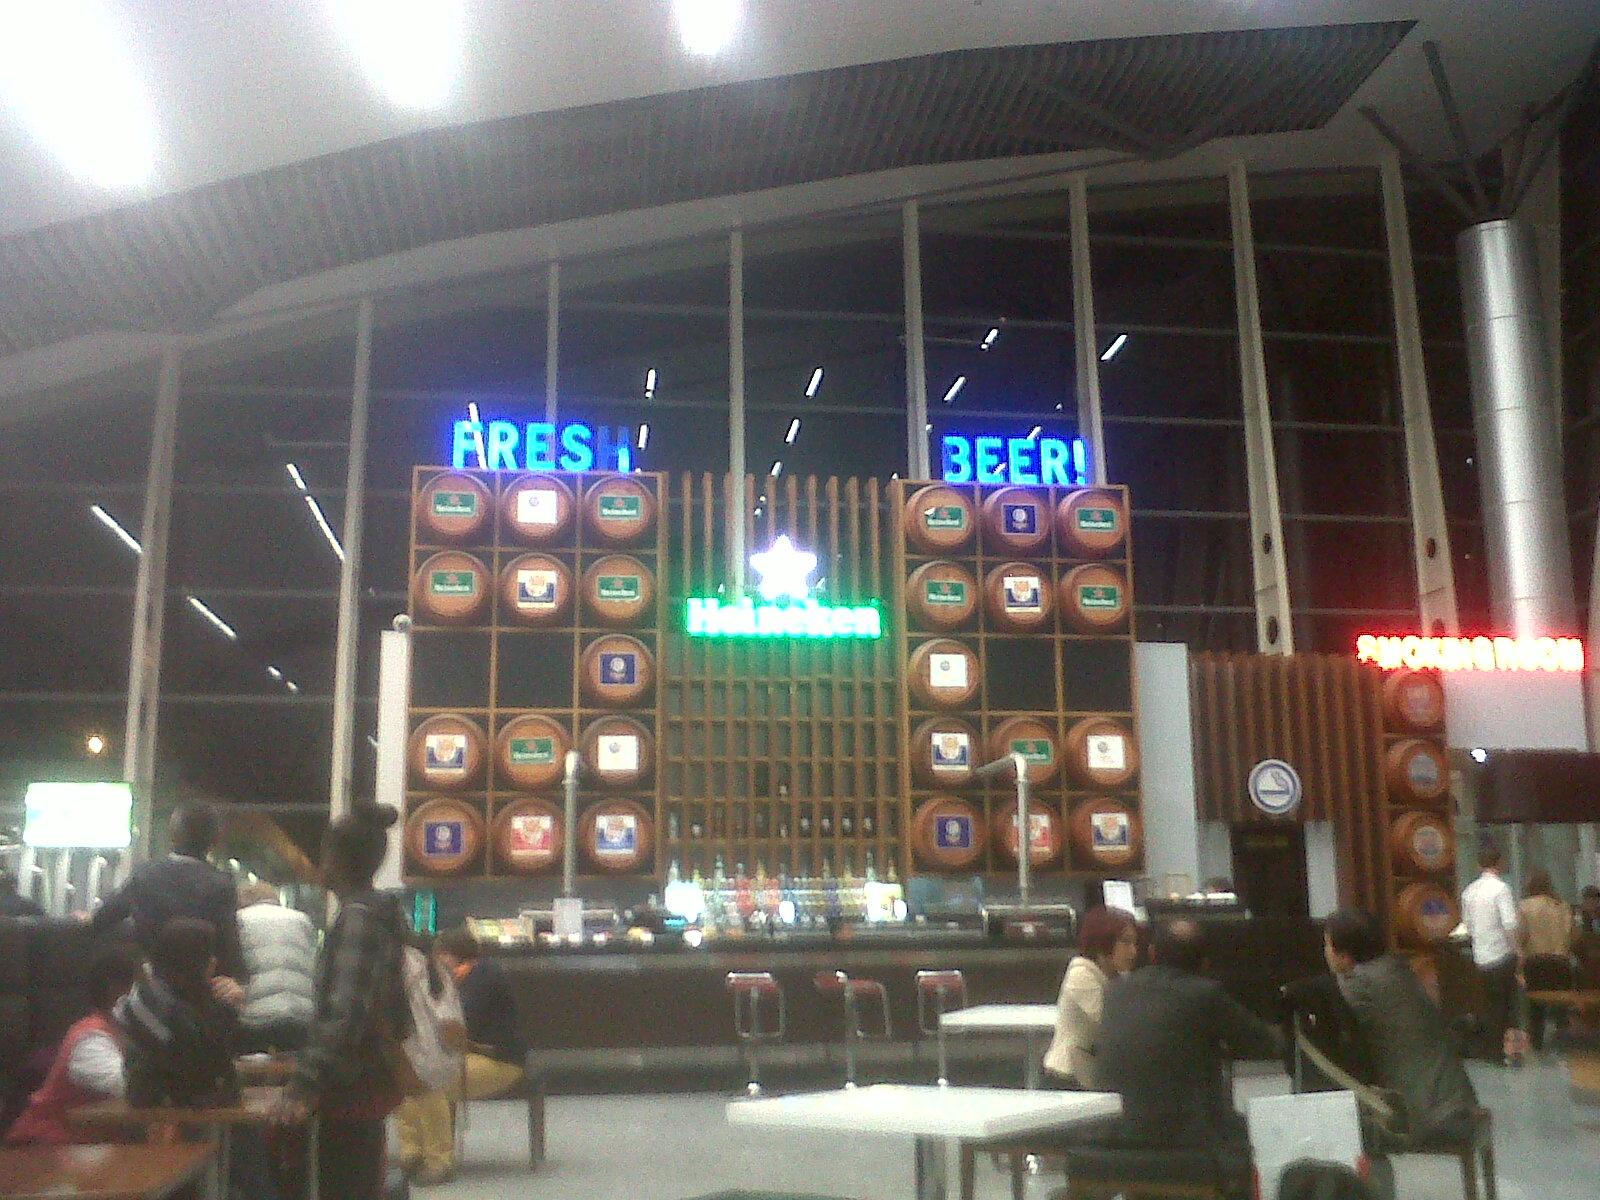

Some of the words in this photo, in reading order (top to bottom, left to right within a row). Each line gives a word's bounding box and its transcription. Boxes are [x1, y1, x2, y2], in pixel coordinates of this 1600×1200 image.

[453, 420, 633, 472] FRESH
[943, 435, 1088, 486] BEER!
[1356, 634, 1494, 671] SMOKING
[1494, 636, 1585, 671] ROOM
